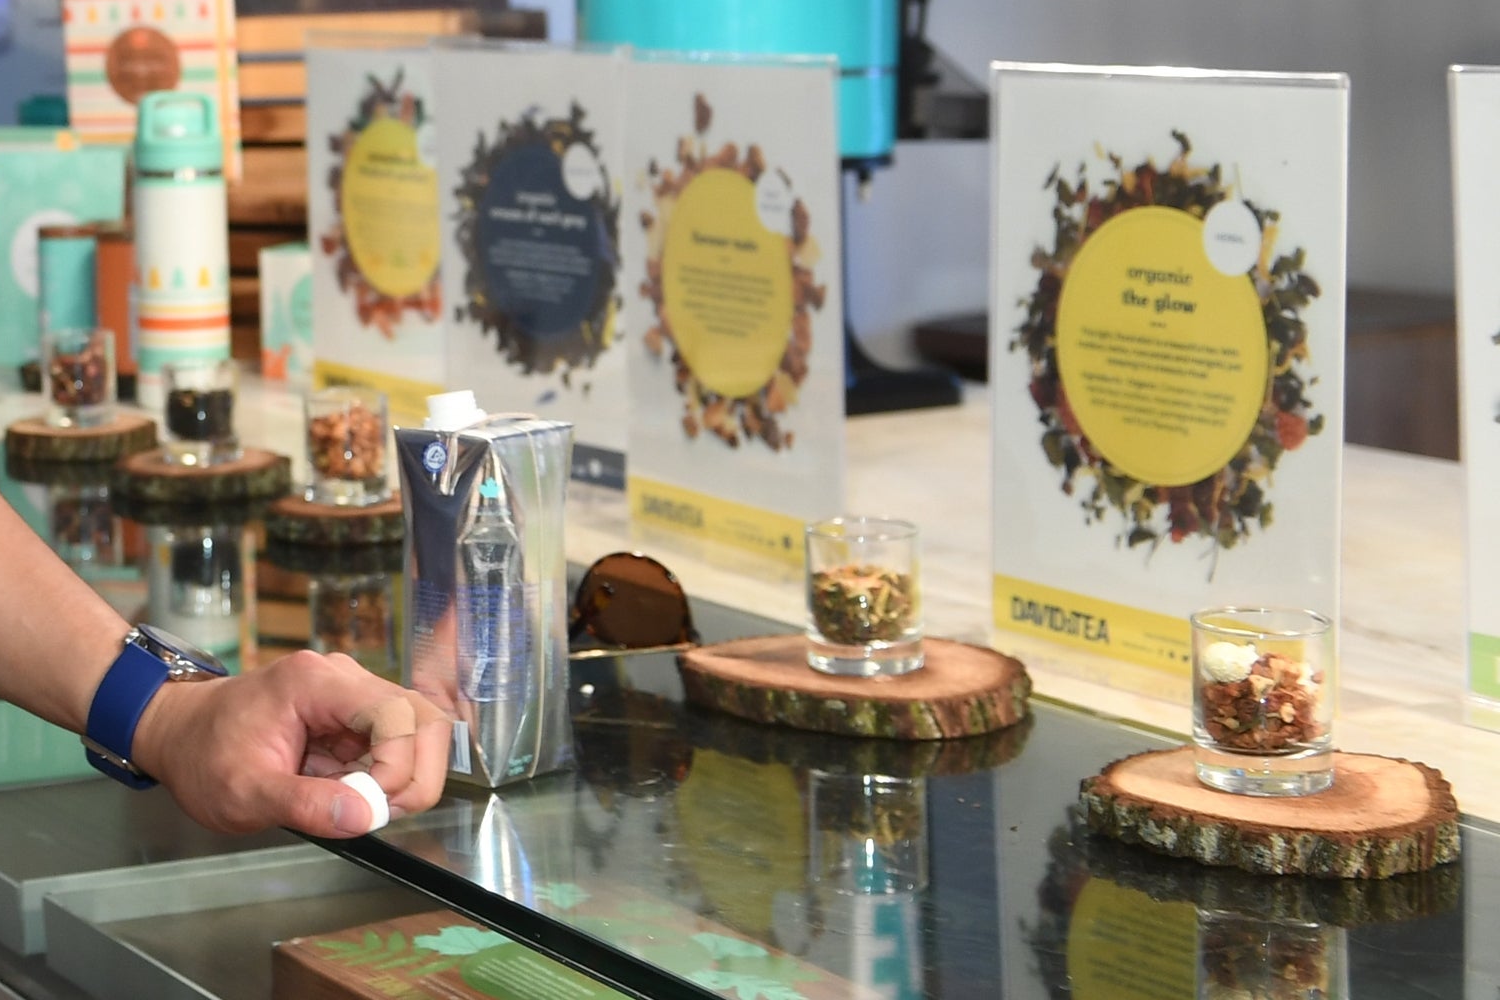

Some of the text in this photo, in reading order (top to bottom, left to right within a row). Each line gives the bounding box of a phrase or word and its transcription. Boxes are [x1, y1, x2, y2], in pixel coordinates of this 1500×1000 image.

[1127, 266, 1193, 287] organic
[1122, 288, 1197, 315] the glow
